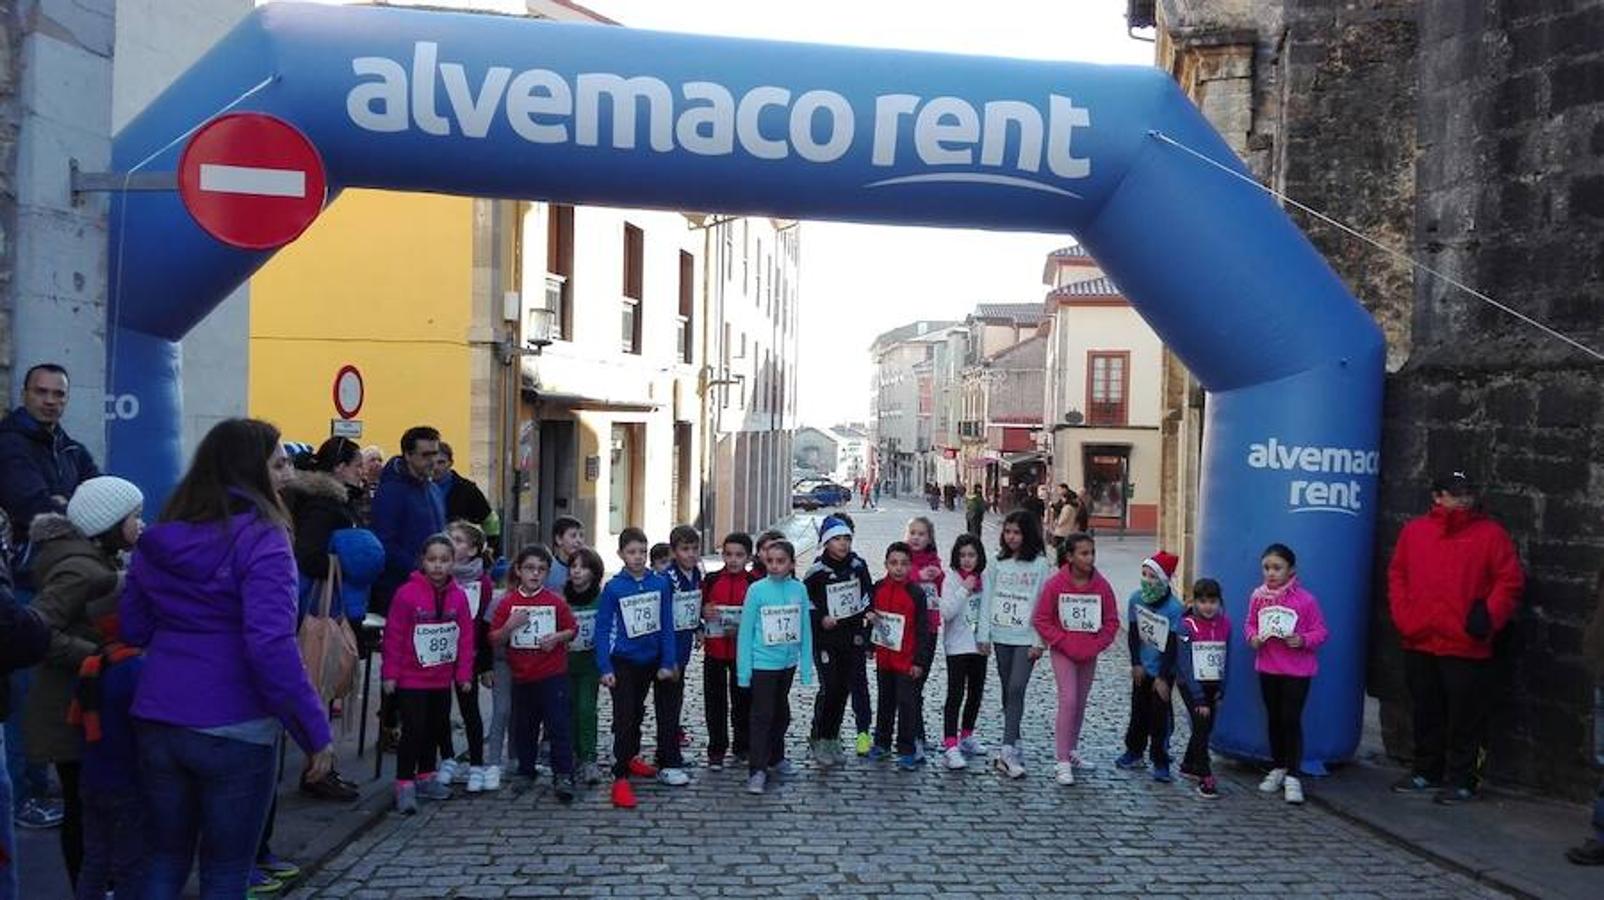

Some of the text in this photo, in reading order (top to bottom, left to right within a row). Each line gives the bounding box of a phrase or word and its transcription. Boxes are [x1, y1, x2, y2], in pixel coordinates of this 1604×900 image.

[346, 41, 1092, 179] alvemaco rent
[1289, 480, 1361, 510] rent
[635, 606, 652, 620] 78
[684, 602, 696, 616] 79
[1002, 601, 1017, 616] 91
[1072, 606, 1087, 619] 81
[778, 618, 790, 631] 17
[429, 637, 448, 652] 89
